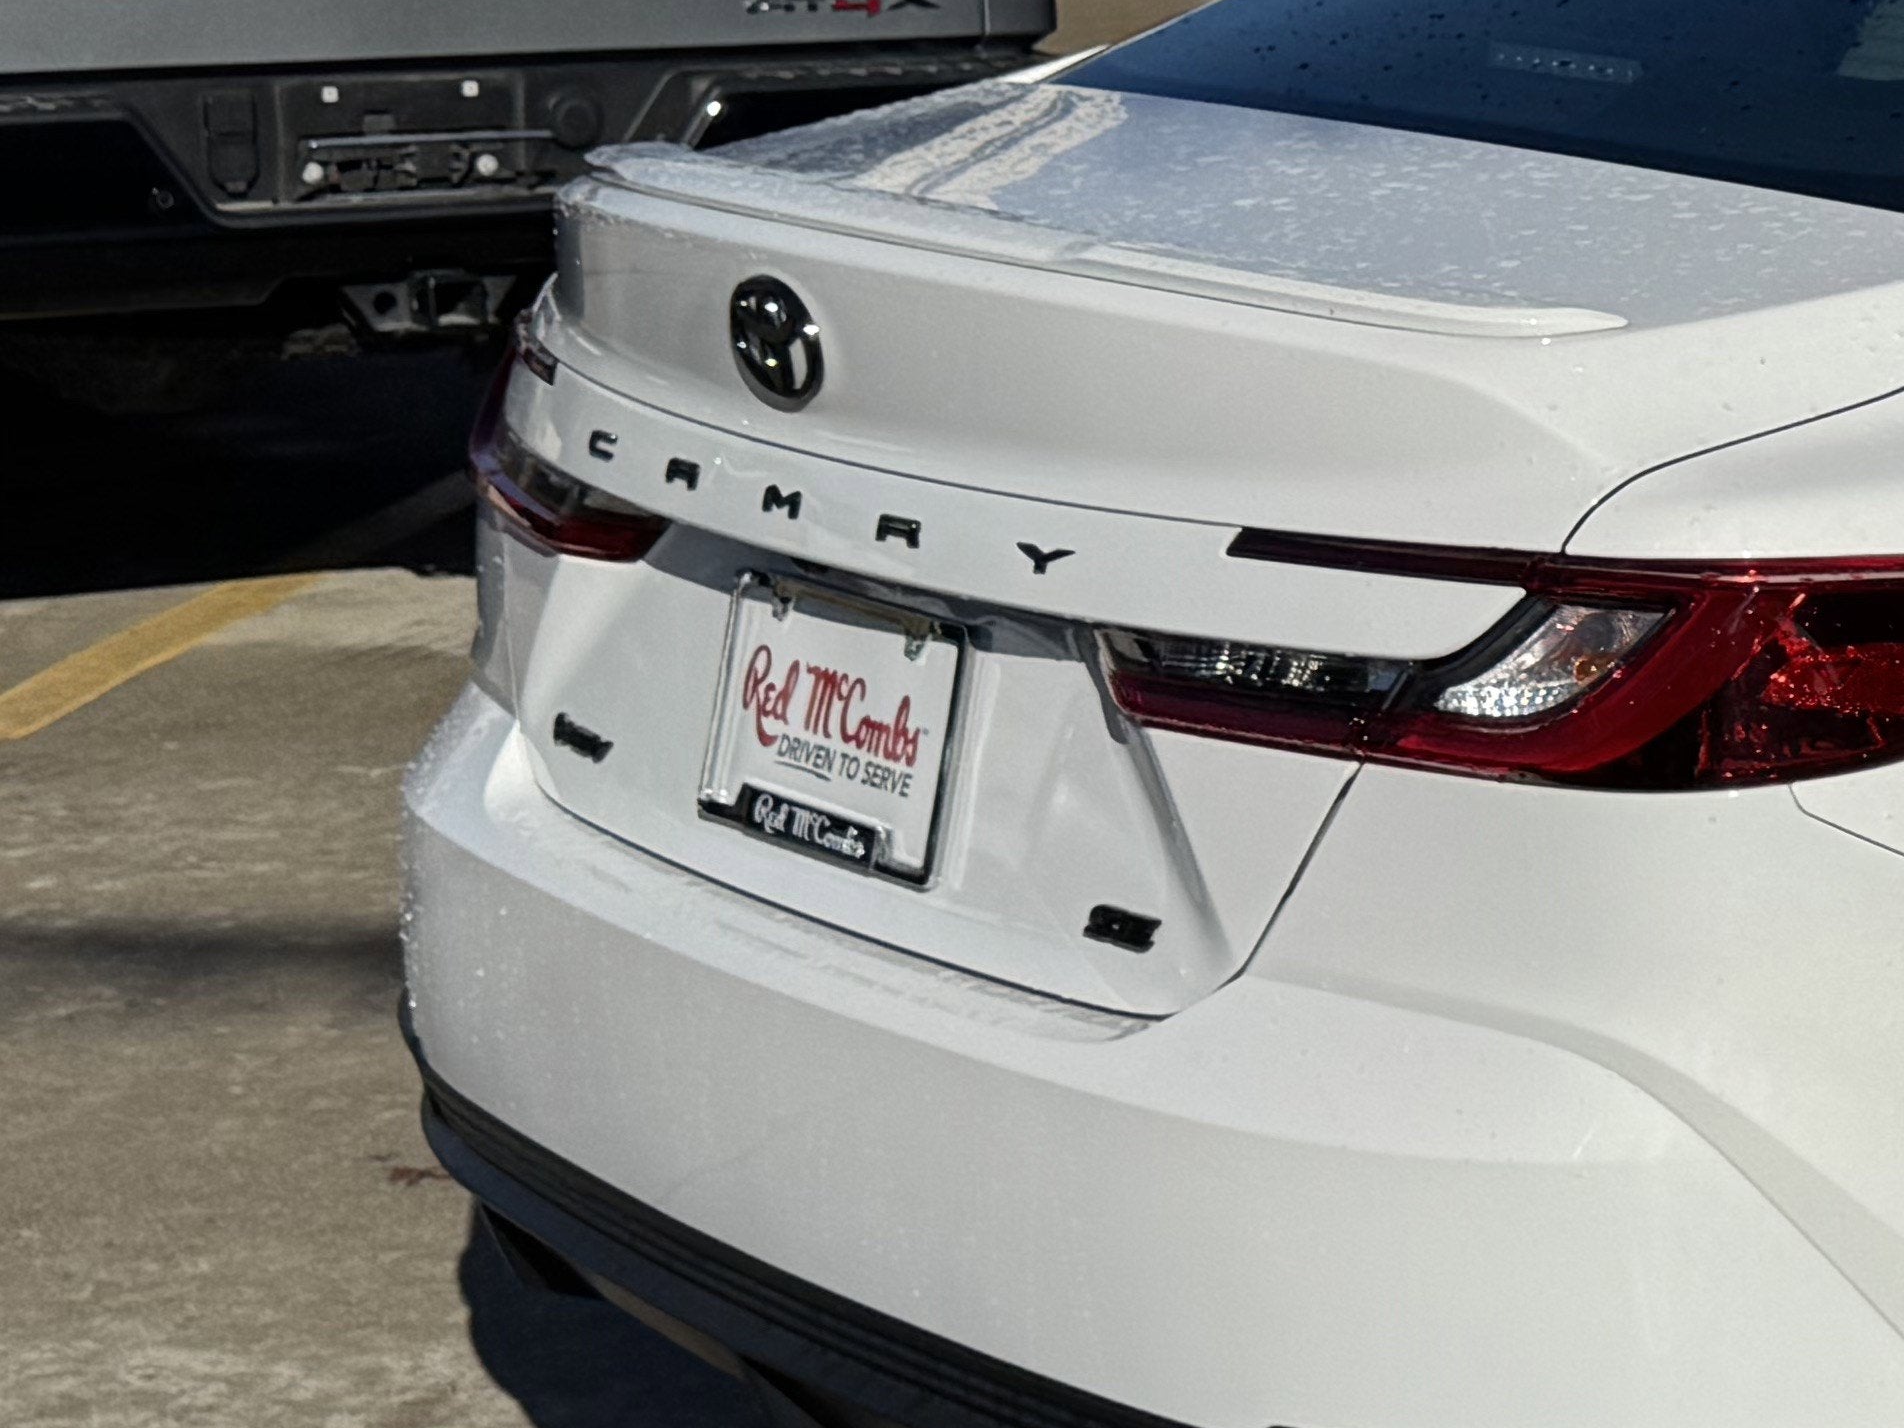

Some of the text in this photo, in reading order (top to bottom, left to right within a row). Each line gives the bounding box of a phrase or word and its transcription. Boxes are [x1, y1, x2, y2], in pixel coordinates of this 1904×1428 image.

[588, 429, 1076, 575] CAMRY
[742, 643, 921, 767] Red McCombs
[777, 733, 914, 798] DRIVEN TO SERVE
[753, 794, 788, 834] Red
